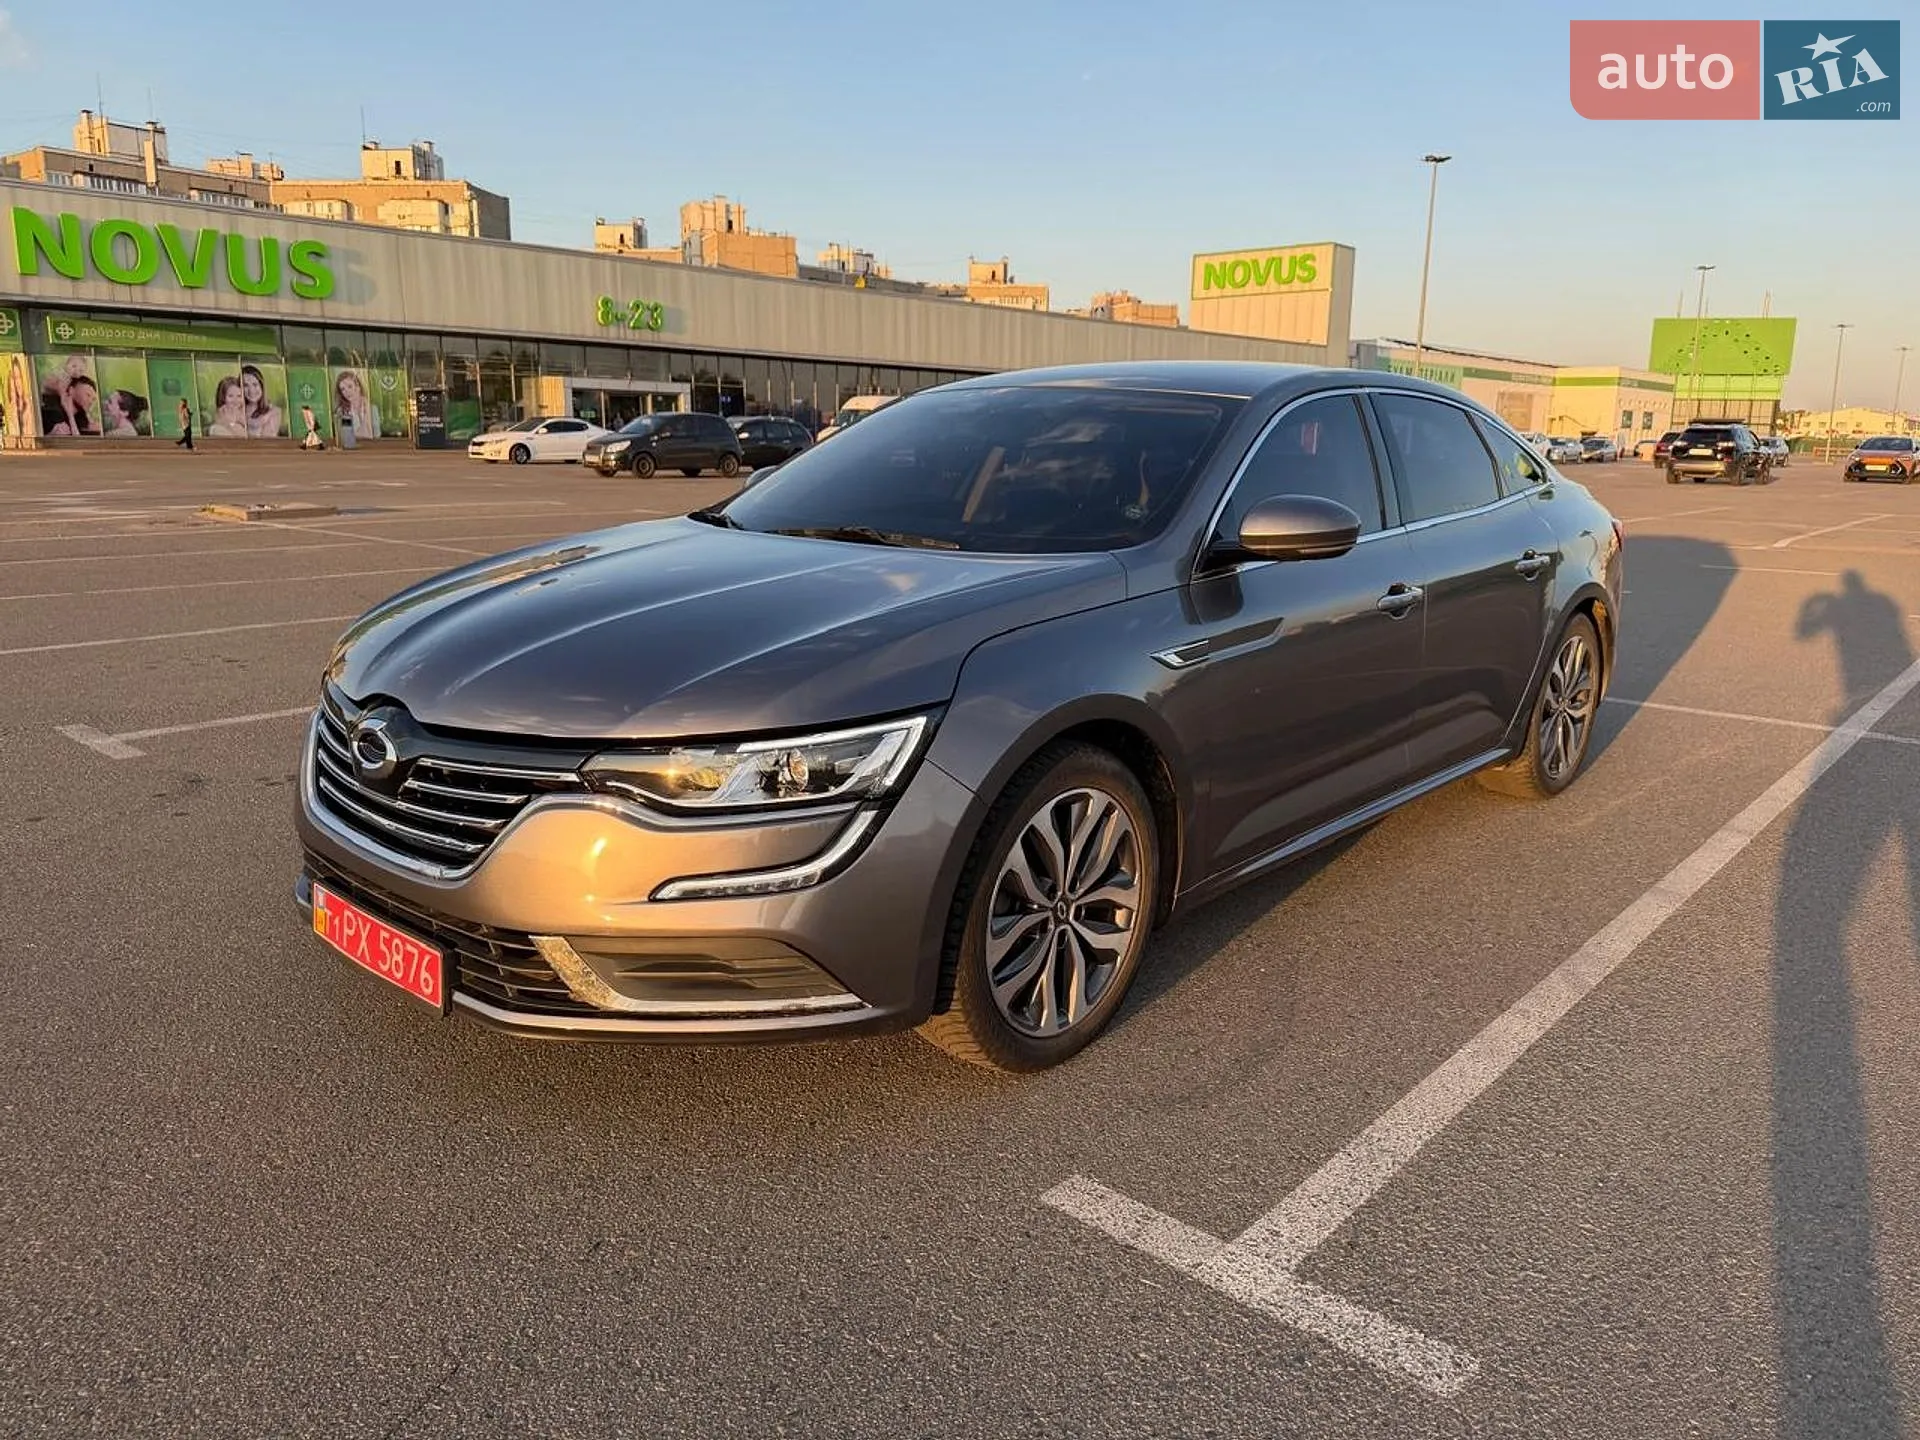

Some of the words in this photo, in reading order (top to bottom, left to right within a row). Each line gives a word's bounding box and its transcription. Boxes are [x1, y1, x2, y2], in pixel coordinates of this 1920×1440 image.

[10, 206, 335, 299] NOVUS
[1203, 253, 1317, 290] NOVUS
[596, 295, 663, 332] 8-23
[378, 930, 434, 996] 5876
